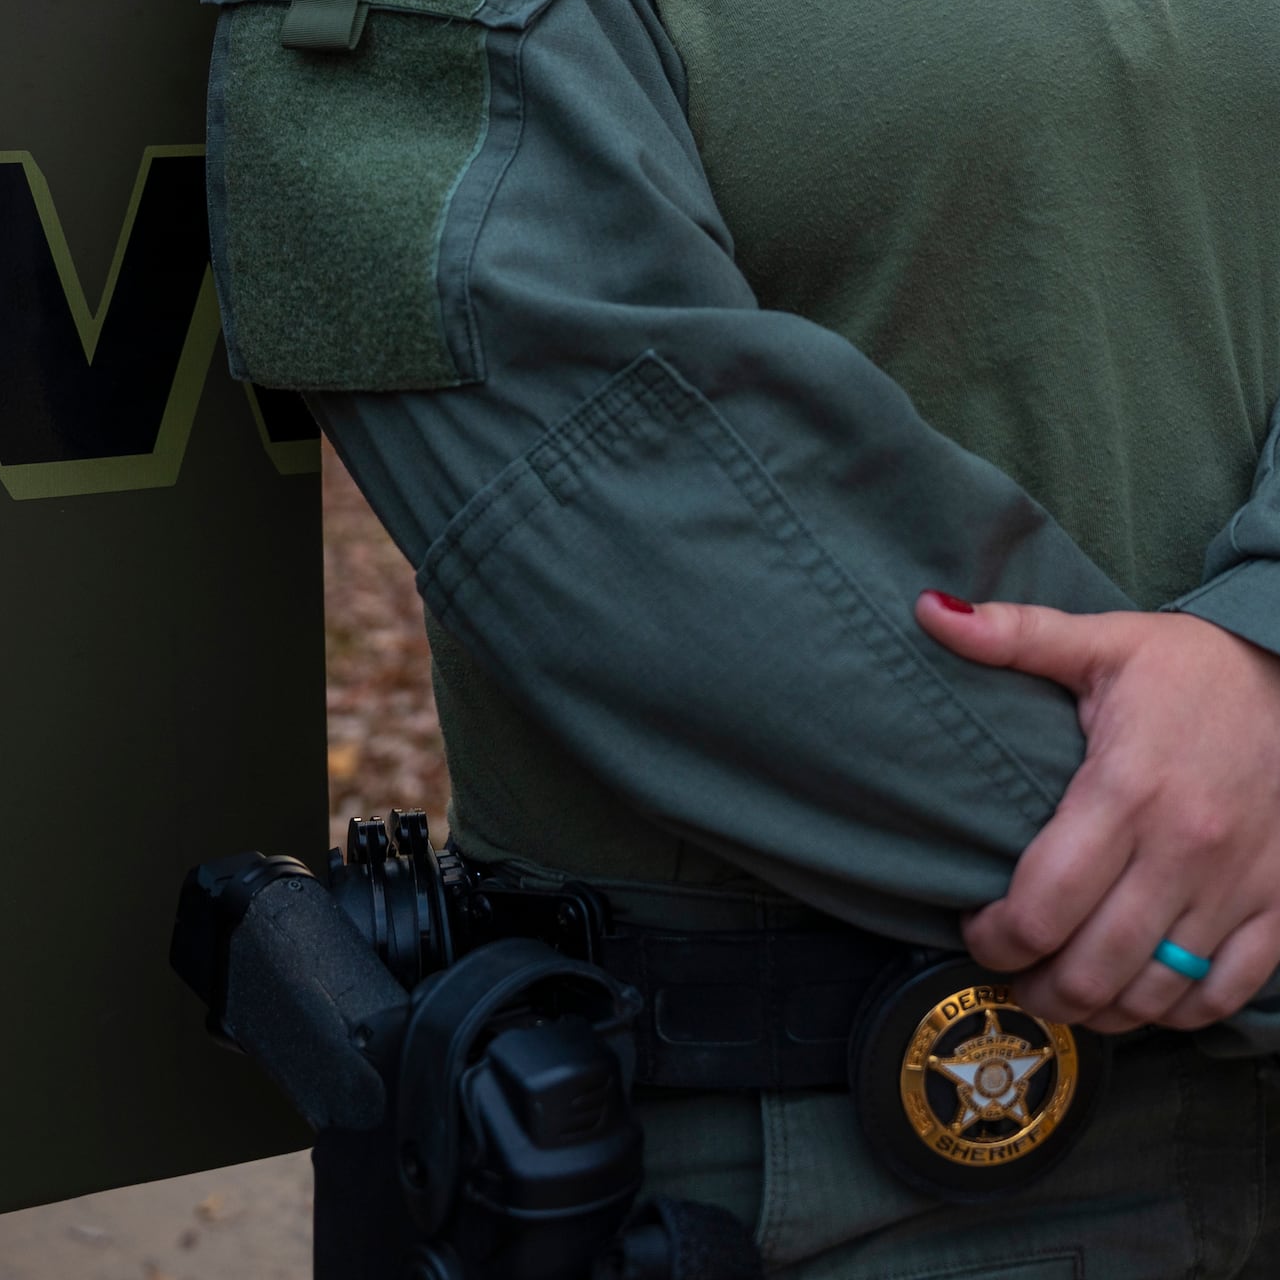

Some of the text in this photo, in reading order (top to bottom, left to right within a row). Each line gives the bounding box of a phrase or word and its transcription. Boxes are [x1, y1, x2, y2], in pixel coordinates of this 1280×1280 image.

[942, 987, 1009, 1021] DEPU
[959, 1034, 1029, 1055] SHERIFF'S
[975, 1048, 1013, 1059] OFFICE
[936, 1124, 1042, 1161] SHERIFF
